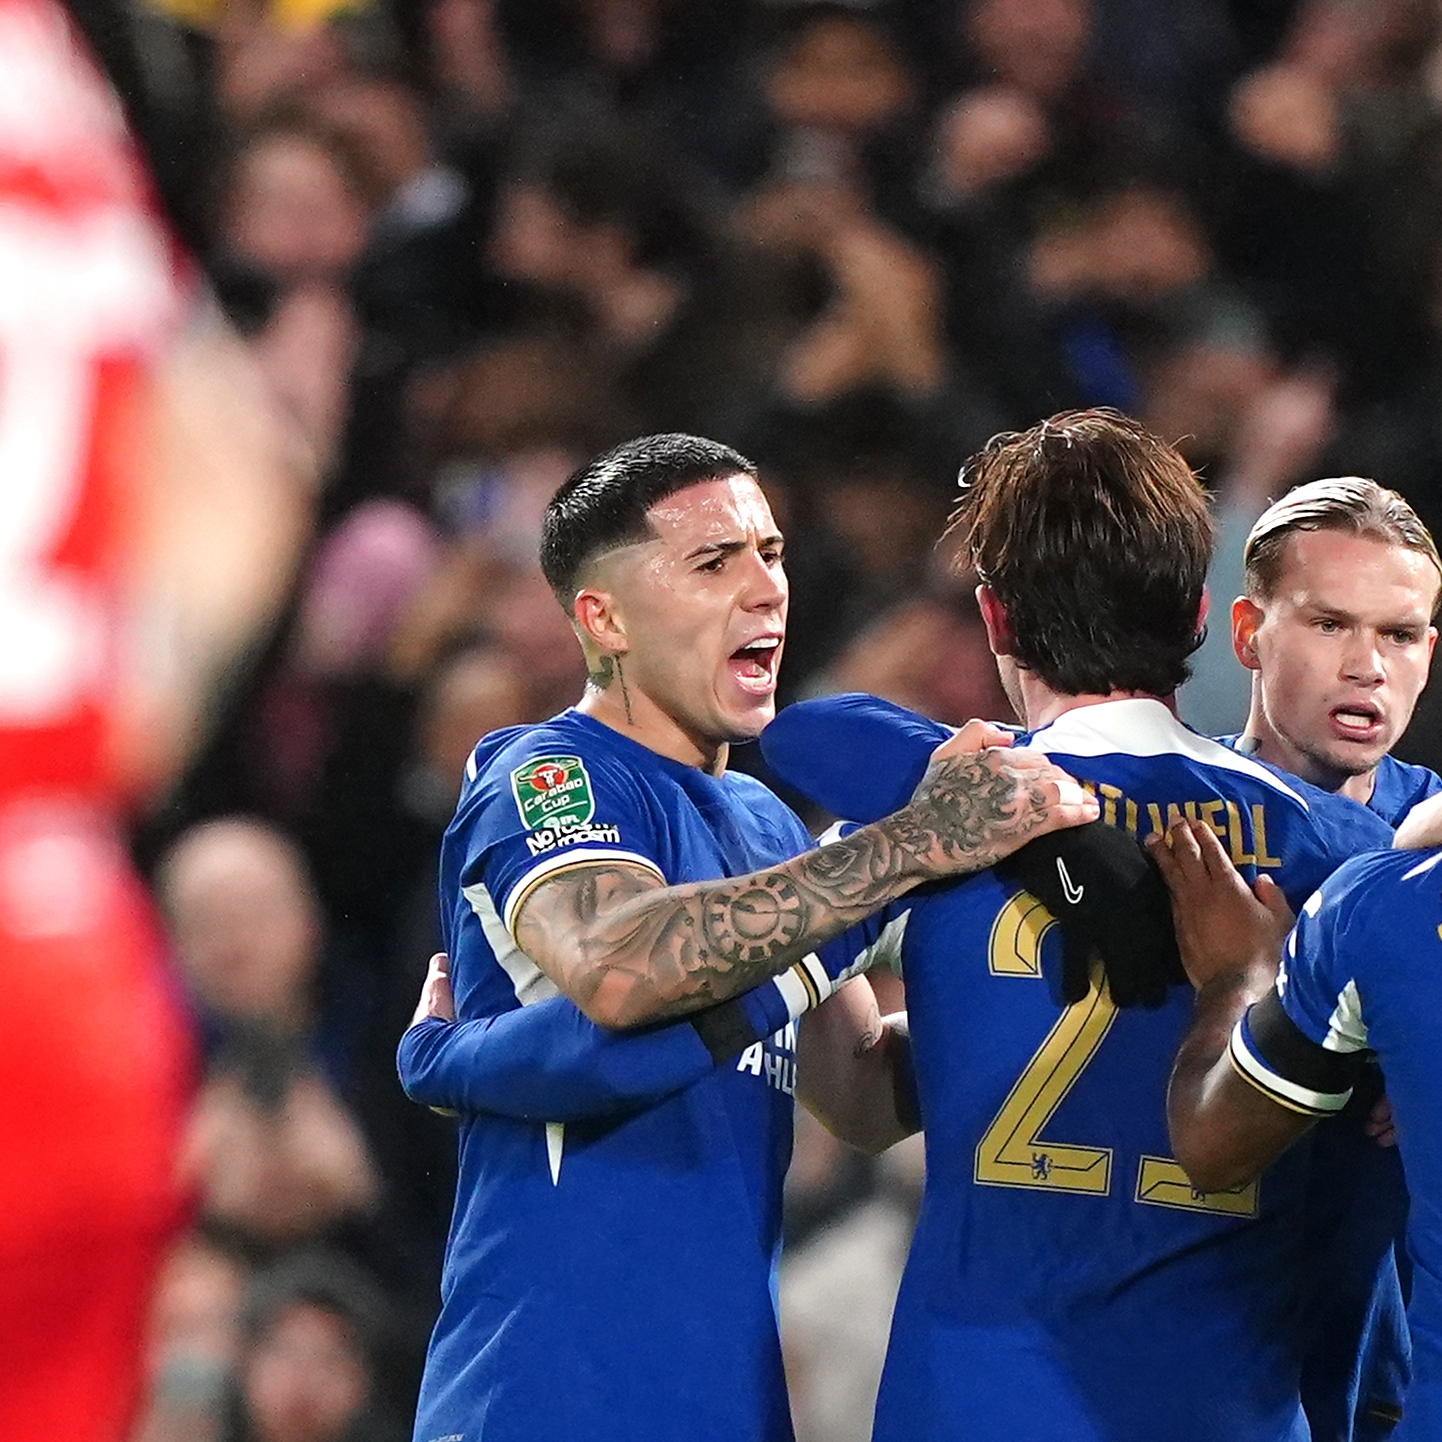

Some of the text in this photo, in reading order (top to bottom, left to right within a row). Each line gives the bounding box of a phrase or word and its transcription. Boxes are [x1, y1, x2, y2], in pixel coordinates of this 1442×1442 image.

[524, 778, 584, 812] Carabao
[542, 795, 571, 813] Cup
[526, 830, 554, 856] No
[973, 890, 1259, 1219] 2
